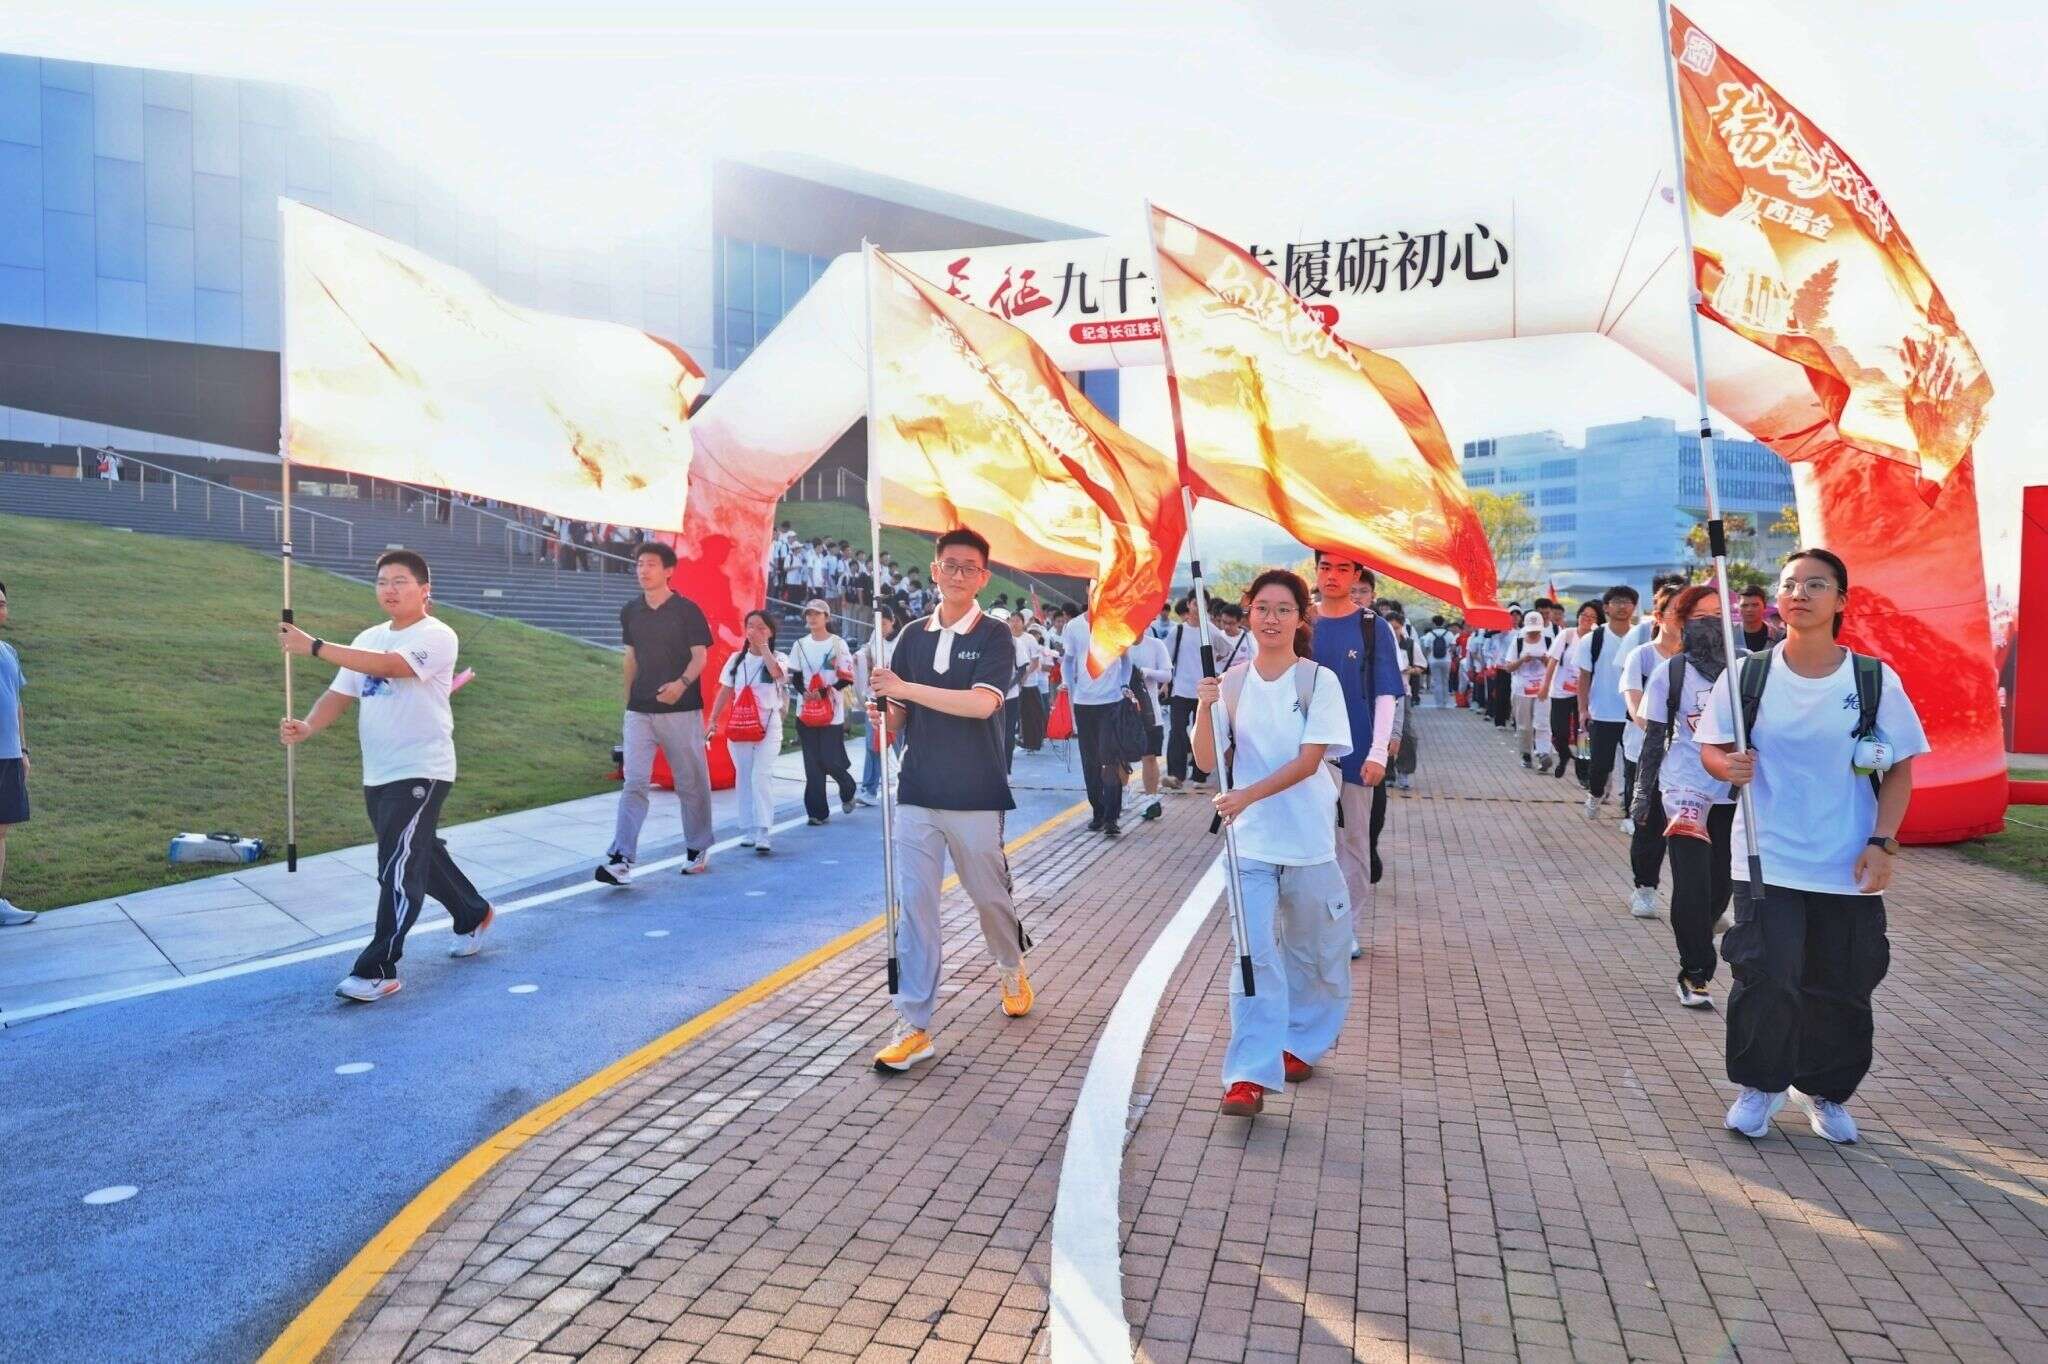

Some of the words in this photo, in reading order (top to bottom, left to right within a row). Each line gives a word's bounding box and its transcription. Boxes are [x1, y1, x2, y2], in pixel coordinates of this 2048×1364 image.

[945, 256, 1157, 319] 长征九十
[1680, 807, 1699, 820] 23
